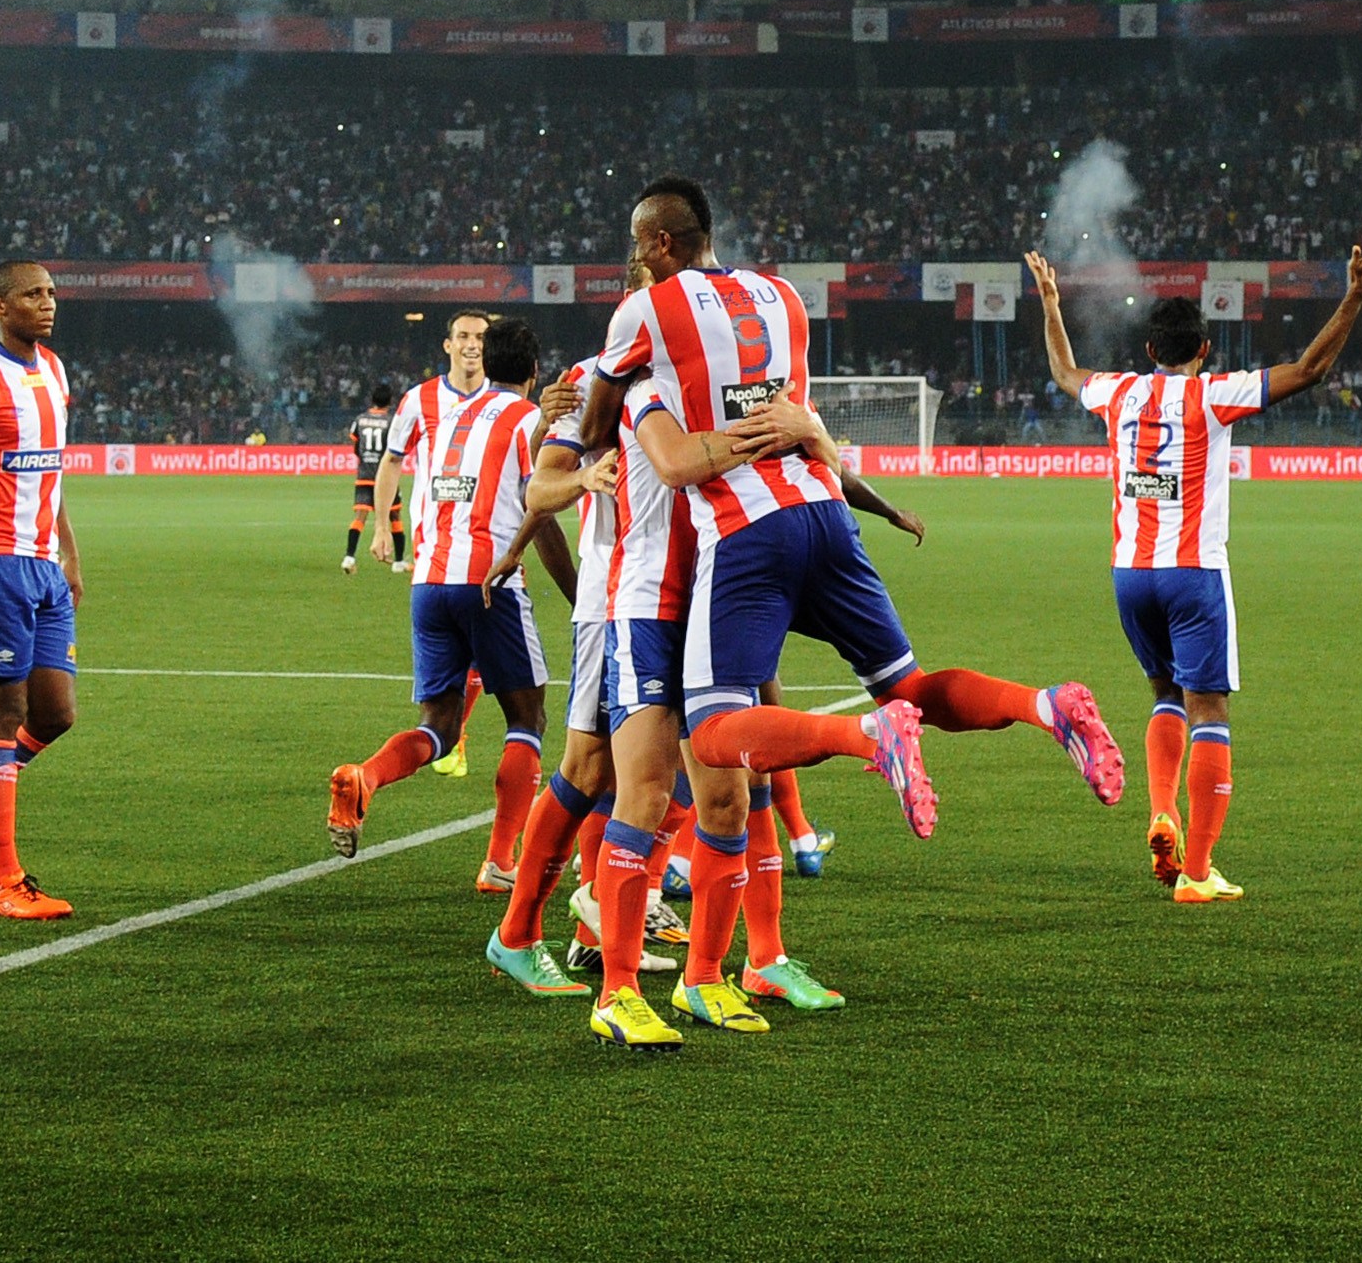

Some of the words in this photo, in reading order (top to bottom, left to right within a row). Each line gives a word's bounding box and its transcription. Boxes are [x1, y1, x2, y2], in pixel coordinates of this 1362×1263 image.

[99, 274, 141, 287] SUPER
[144, 274, 194, 287] LEAGUE
[585, 279, 621, 292] HERO
[695, 286, 778, 311] FIKRU
[732, 313, 772, 374] 9
[725, 385, 767, 404] Apollo
[361, 427, 383, 451] 11
[441, 425, 474, 472] 5
[1122, 420, 1173, 467] 12
[7, 451, 62, 470] AIRCEL
[1127, 474, 1160, 487] Apollo
[1135, 484, 1172, 497] Munich
